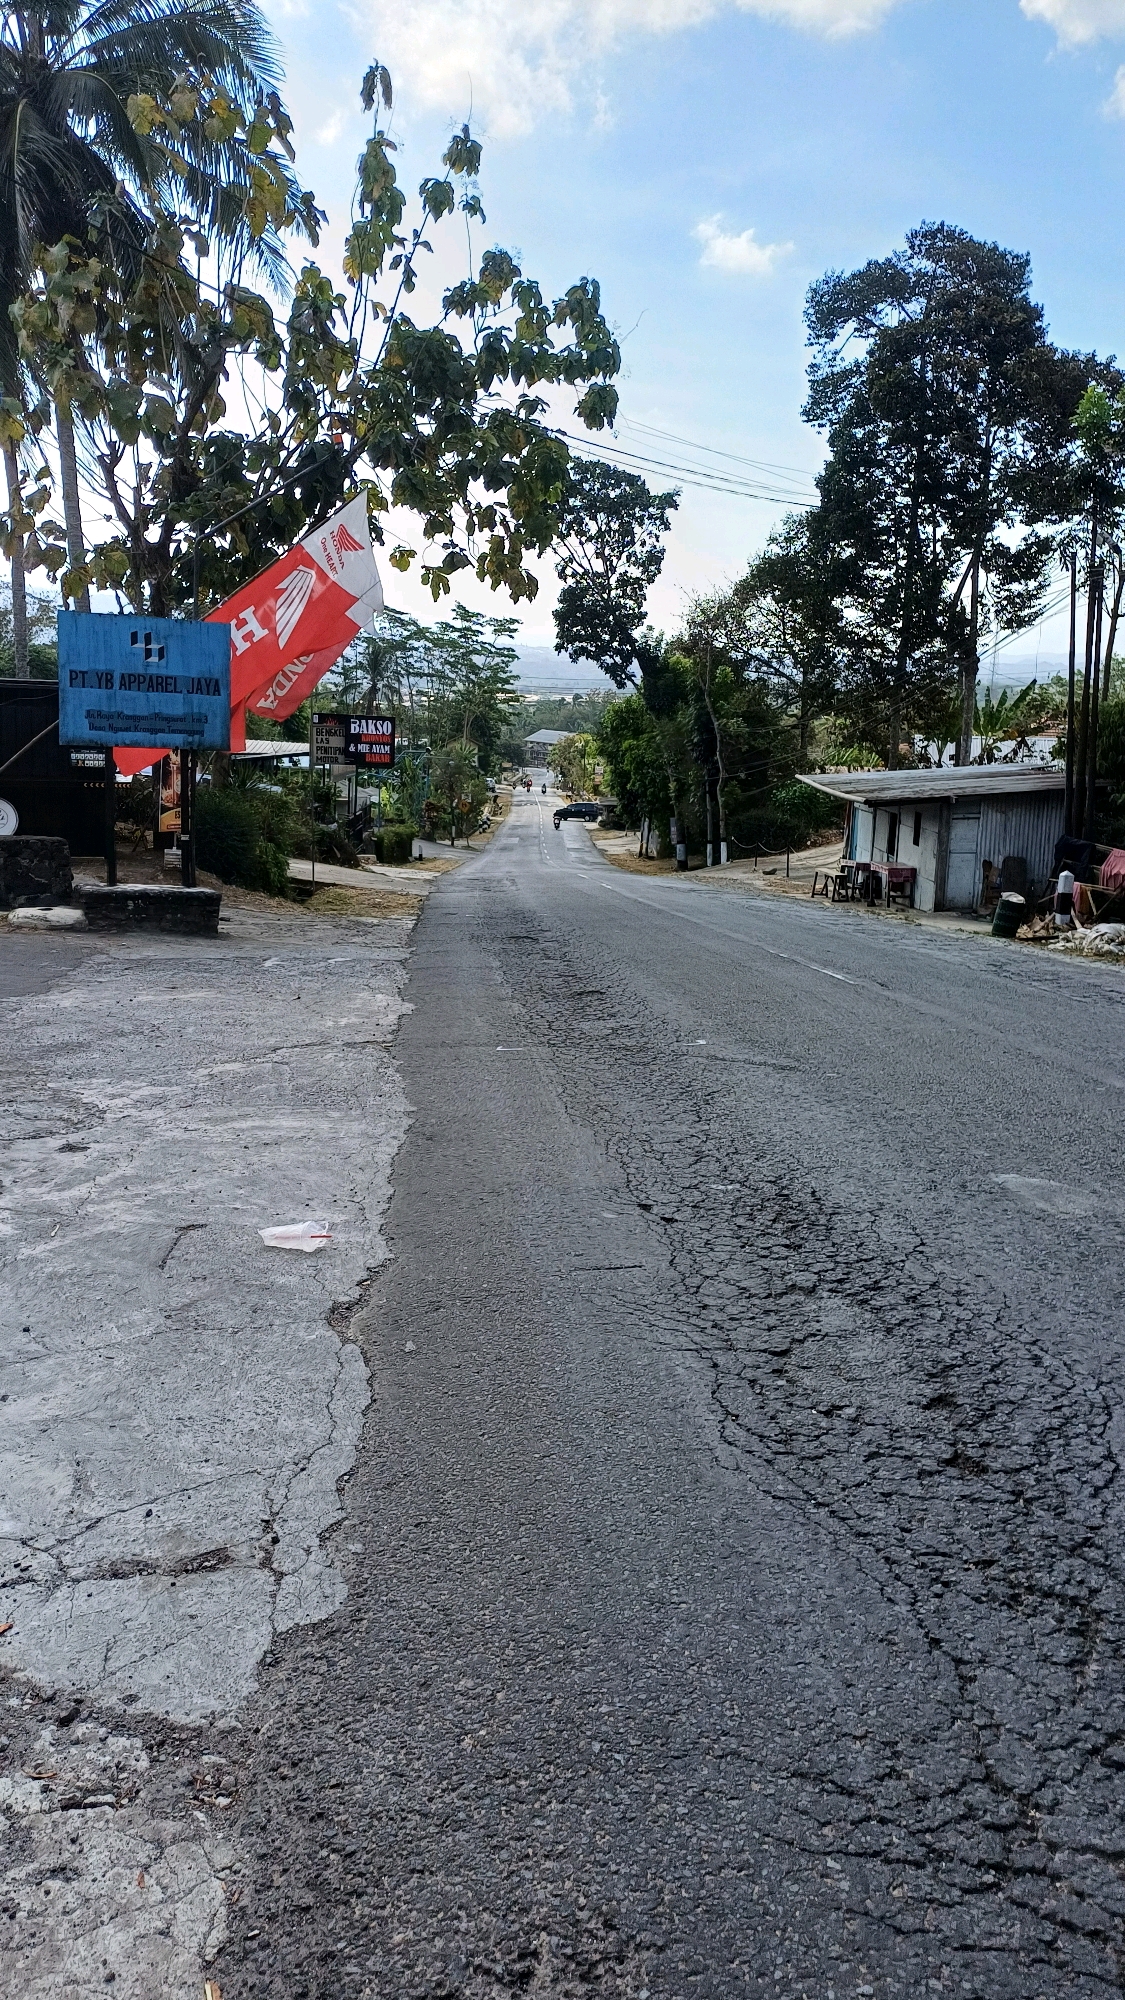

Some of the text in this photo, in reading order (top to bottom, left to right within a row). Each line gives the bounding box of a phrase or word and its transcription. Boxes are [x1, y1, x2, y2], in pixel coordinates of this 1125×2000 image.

[320, 537, 328, 553] One
[329, 530, 345, 570] HONDA
[119, 673, 183, 694] APPAREL
[186, 677, 222, 696] JAYA
[89, 722, 106, 731] Desa
[316, 728, 345, 737] BENGKEL
[350, 719, 392, 735] BAKSO
[349, 743, 391, 754] & MIE AYAM
